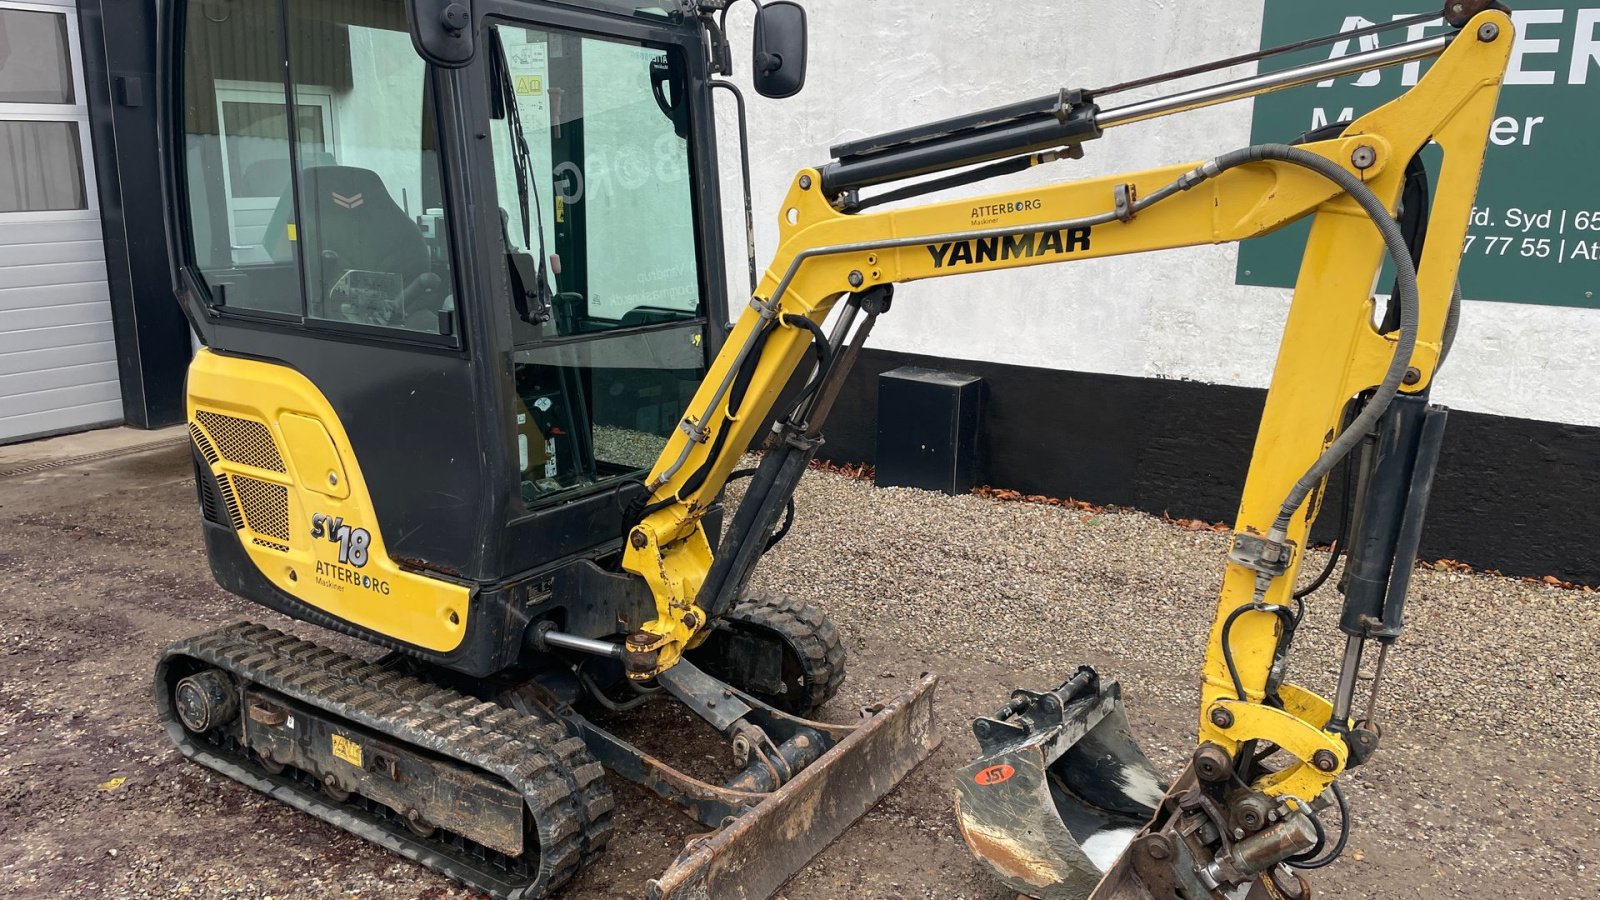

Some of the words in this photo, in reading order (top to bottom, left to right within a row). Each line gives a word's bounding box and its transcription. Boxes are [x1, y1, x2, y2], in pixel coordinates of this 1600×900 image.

[1316, 9, 1600, 88] ATER
[971, 199, 1042, 218] ATTERBORG
[1468, 207, 1495, 226] fd.
[1504, 208, 1552, 232] Syd
[970, 218, 999, 226] Maskiner
[926, 226, 1092, 268] YANMAR
[1484, 236, 1514, 255] 77
[1520, 237, 1551, 257] 55
[1570, 240, 1600, 260] At
[315, 576, 345, 592] Maskiner
[316, 560, 390, 595] ATTERBORG
[985, 767, 1005, 782] JST
